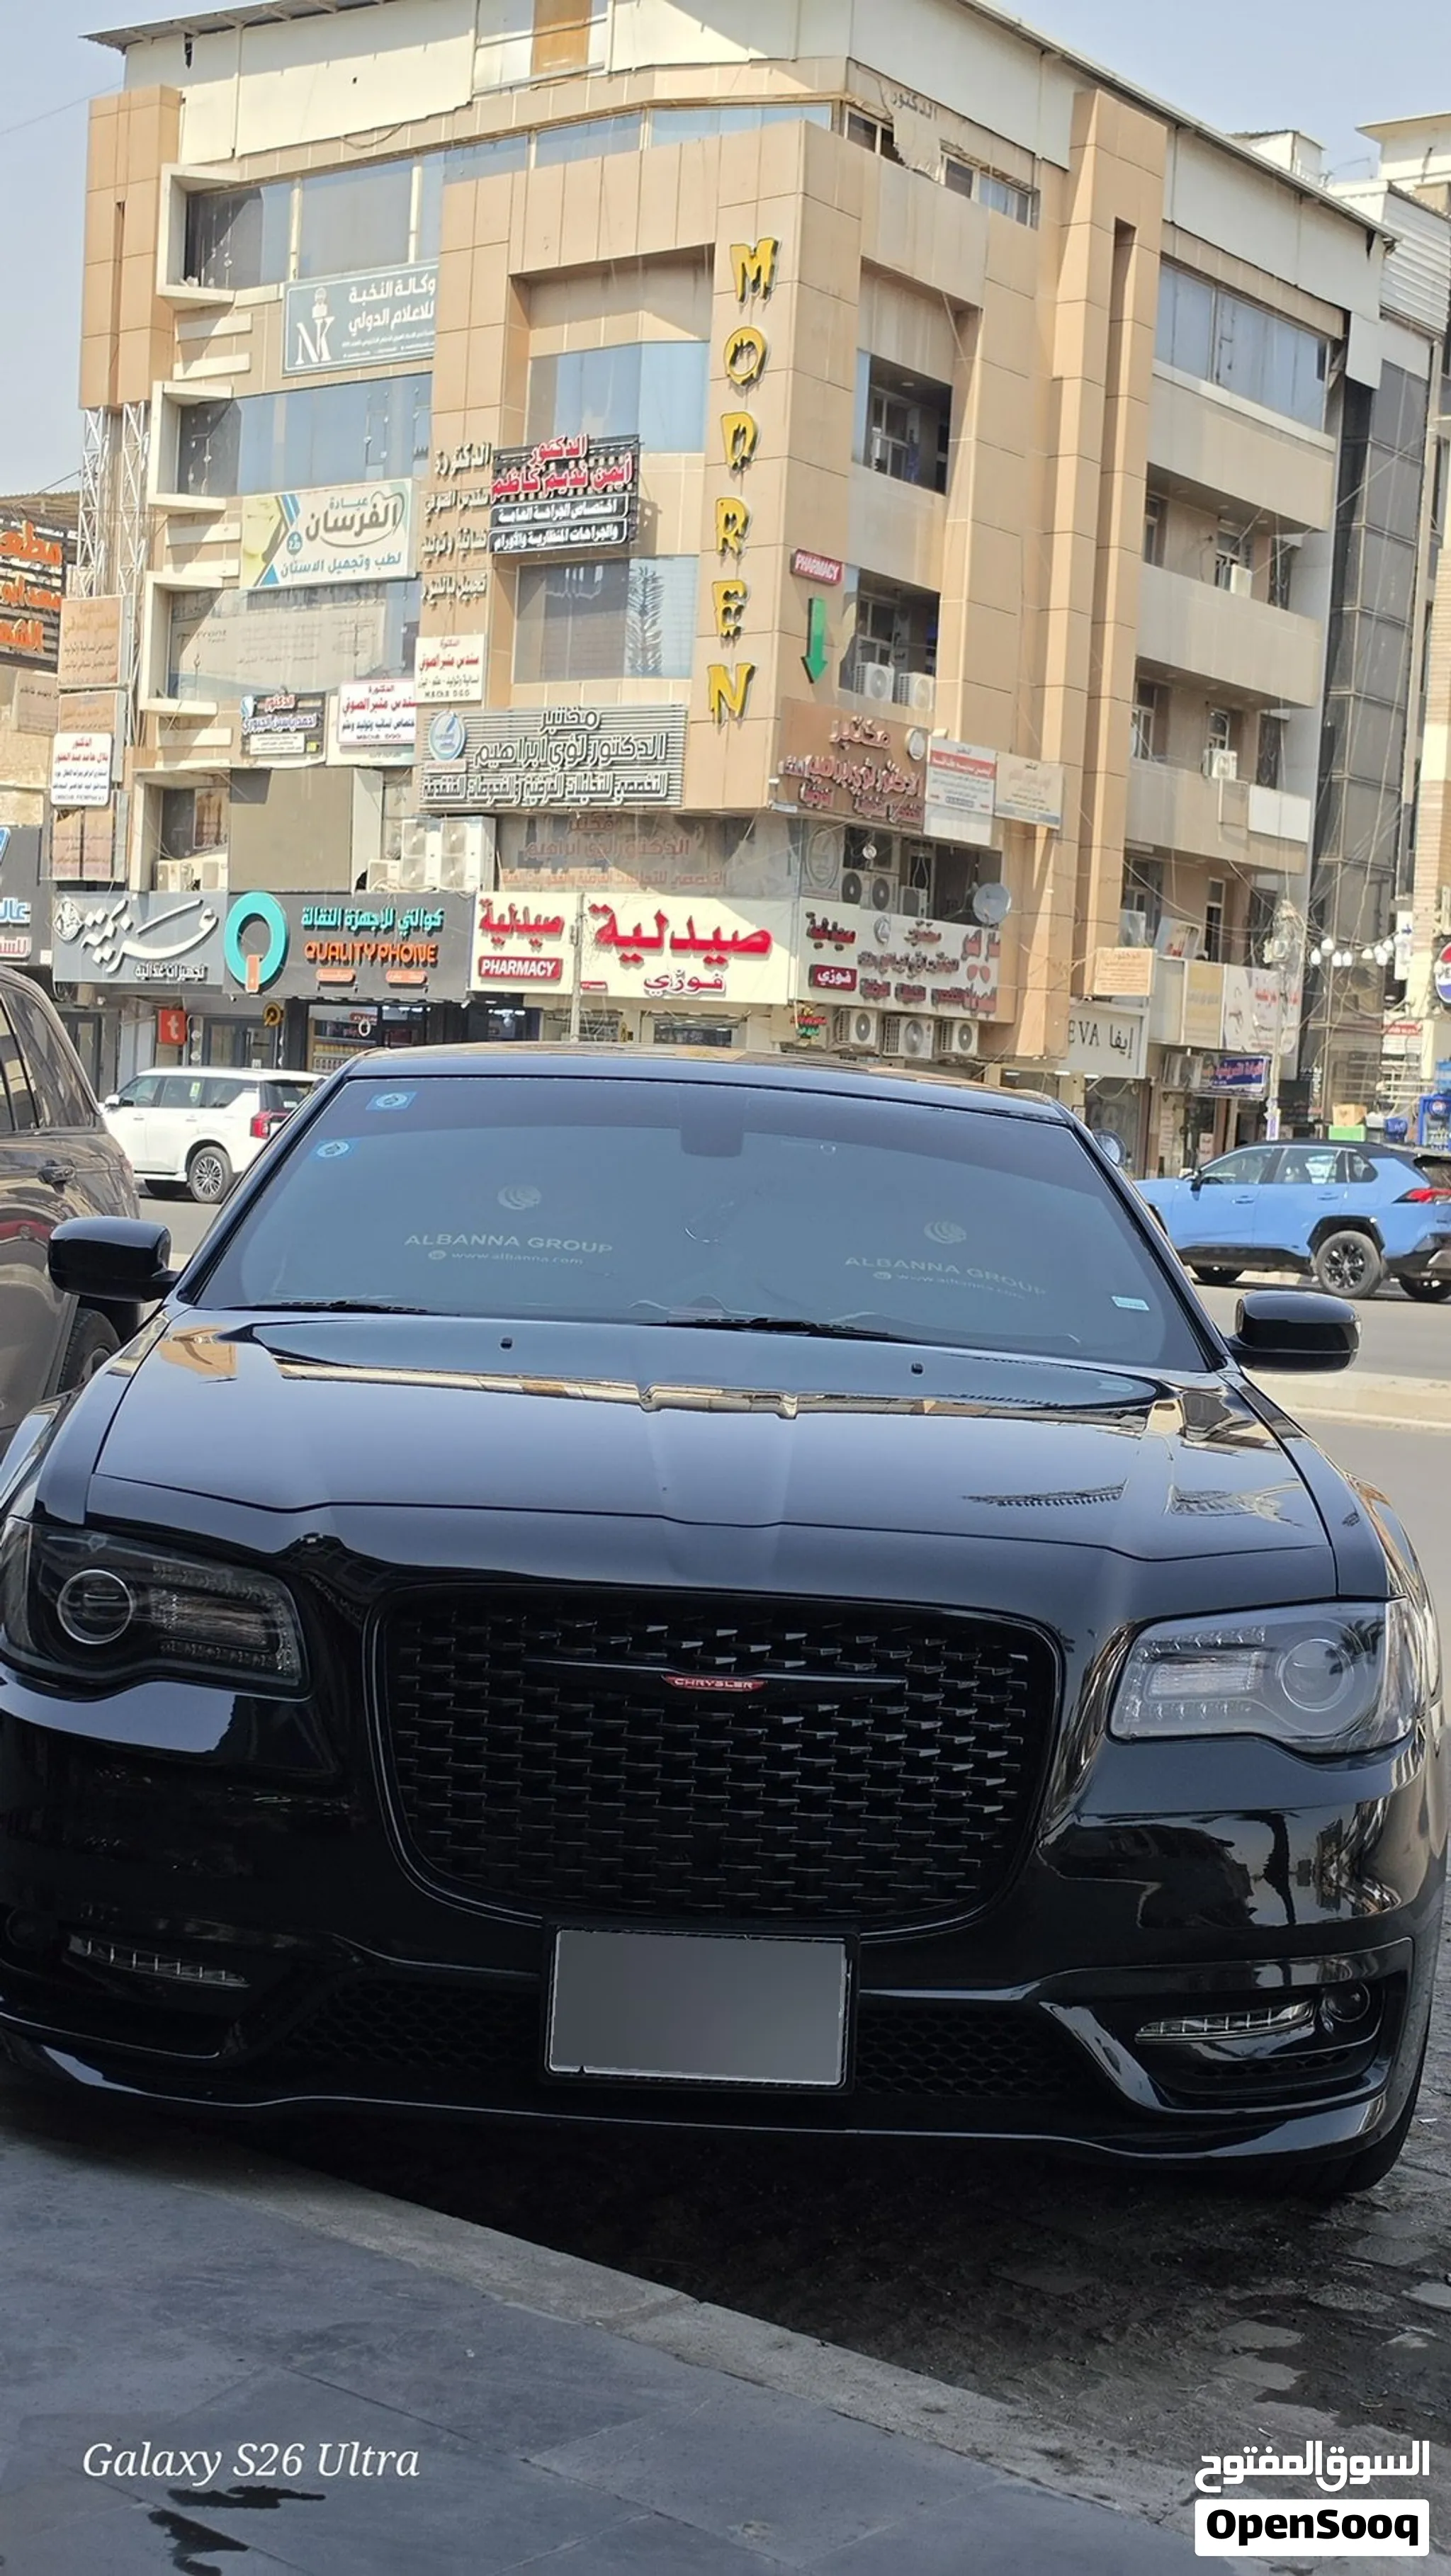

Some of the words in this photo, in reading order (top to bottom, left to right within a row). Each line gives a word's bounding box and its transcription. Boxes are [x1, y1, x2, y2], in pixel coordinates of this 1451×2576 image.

[348, 280, 393, 305] النخبة
[394, 273, 436, 296] وكالة
[348, 308, 389, 336] الدولي
[434, 442, 491, 475] الدكتورة
[531, 433, 589, 466] الدكتور
[329, 497, 368, 511] عيادة
[498, 506, 533, 523] العامة
[534, 502, 570, 521] الجراحة
[305, 503, 397, 541] الفرسان
[328, 555, 371, 574] وتجميل
[375, 552, 401, 570] لطب
[795, 552, 840, 580] PHARMACY
[539, 705, 601, 734] مختبر
[473, 736, 547, 768] ابراهيم
[549, 734, 587, 773] لؤي
[589, 734, 667, 768] الدكتور
[301, 906, 343, 928] النقالة
[397, 907, 445, 937] كوالتي
[479, 899, 565, 947] صيدلية
[806, 911, 856, 951] صيدلية
[588, 904, 772, 966] صيدلية
[481, 958, 557, 977] PHARMACY
[818, 970, 852, 985] فوزي
[644, 970, 723, 996] فوزي
[1110, 1024, 1134, 1060] إيفا
[404, 1233, 520, 1249] ALBANNA
[527, 1237, 614, 1254] GROUP
[845, 1256, 961, 1275] ALBANNA
[966, 1268, 1047, 1295] GROUP
[674, 1678, 753, 1689] CHRYSLER
